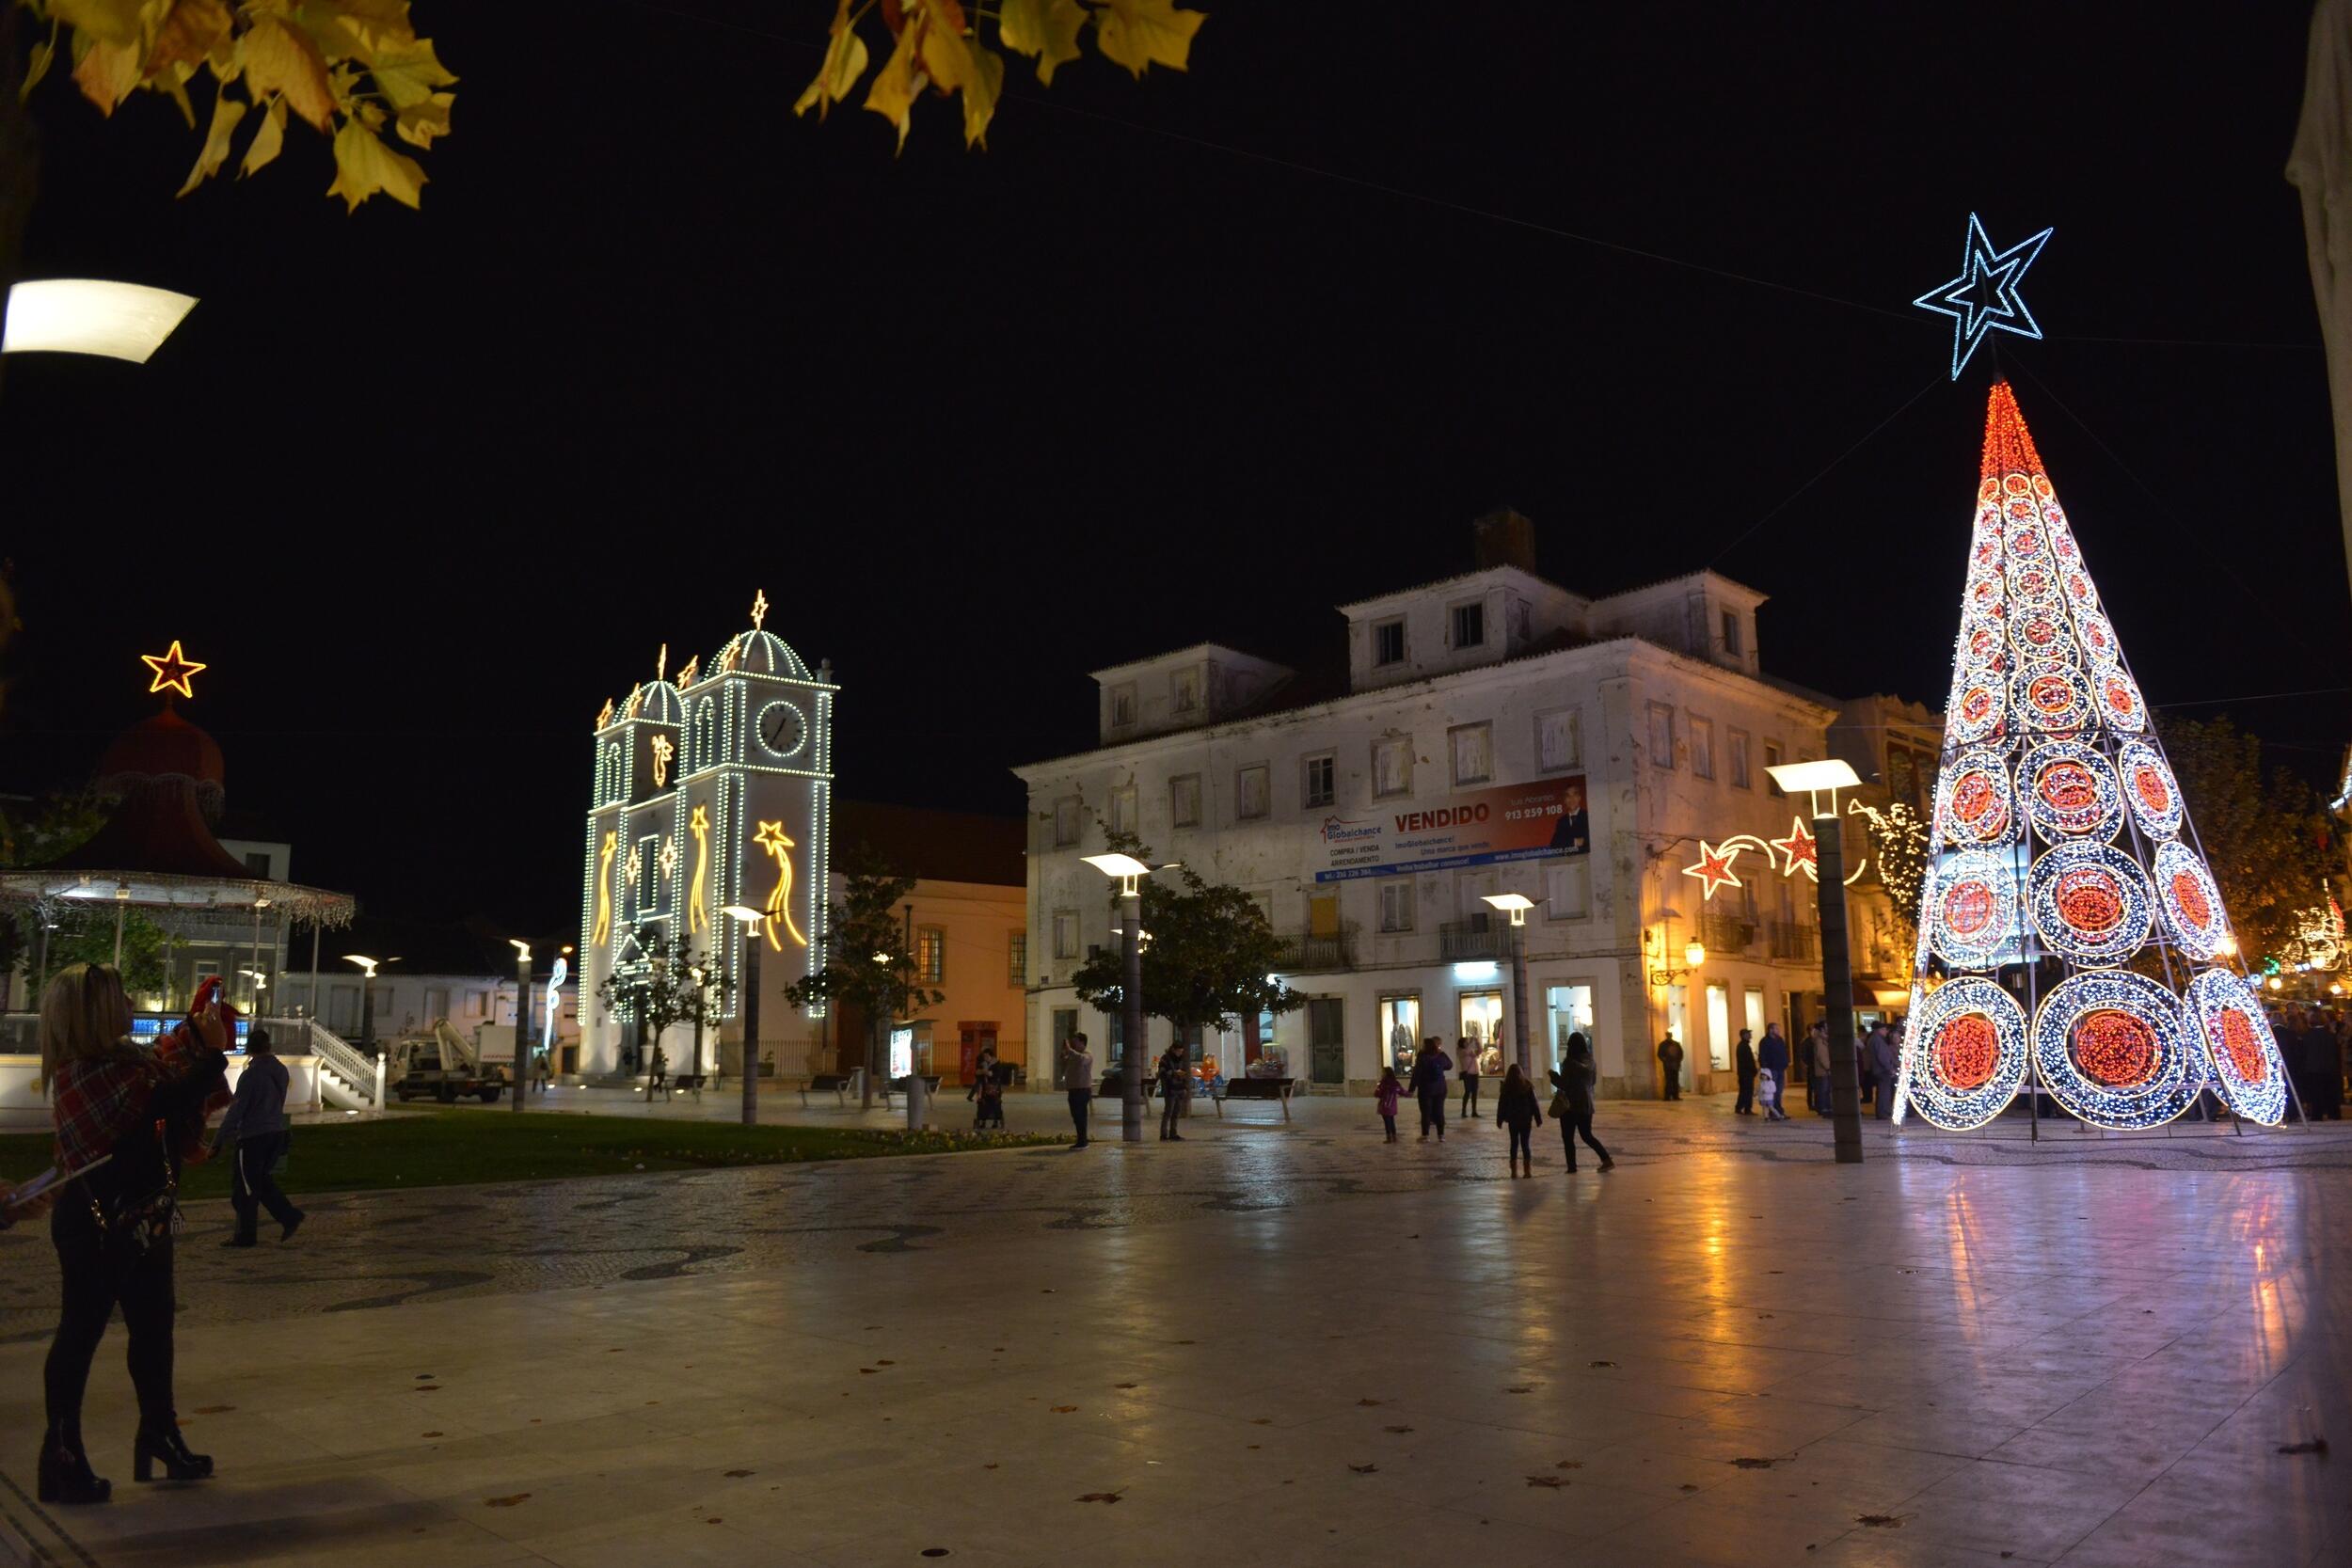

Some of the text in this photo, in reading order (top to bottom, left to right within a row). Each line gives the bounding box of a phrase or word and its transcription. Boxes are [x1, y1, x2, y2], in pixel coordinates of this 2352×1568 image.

[1395, 802, 1490, 832] VENDIDO
[1504, 810, 1521, 821] 913
[1546, 804, 1563, 816] 108
[1327, 827, 1382, 840] Globalchance
[1329, 847, 1355, 857] COMPRA
[1359, 845, 1380, 854] VENDA
[1330, 855, 1380, 866] ARRENDAMENTO
